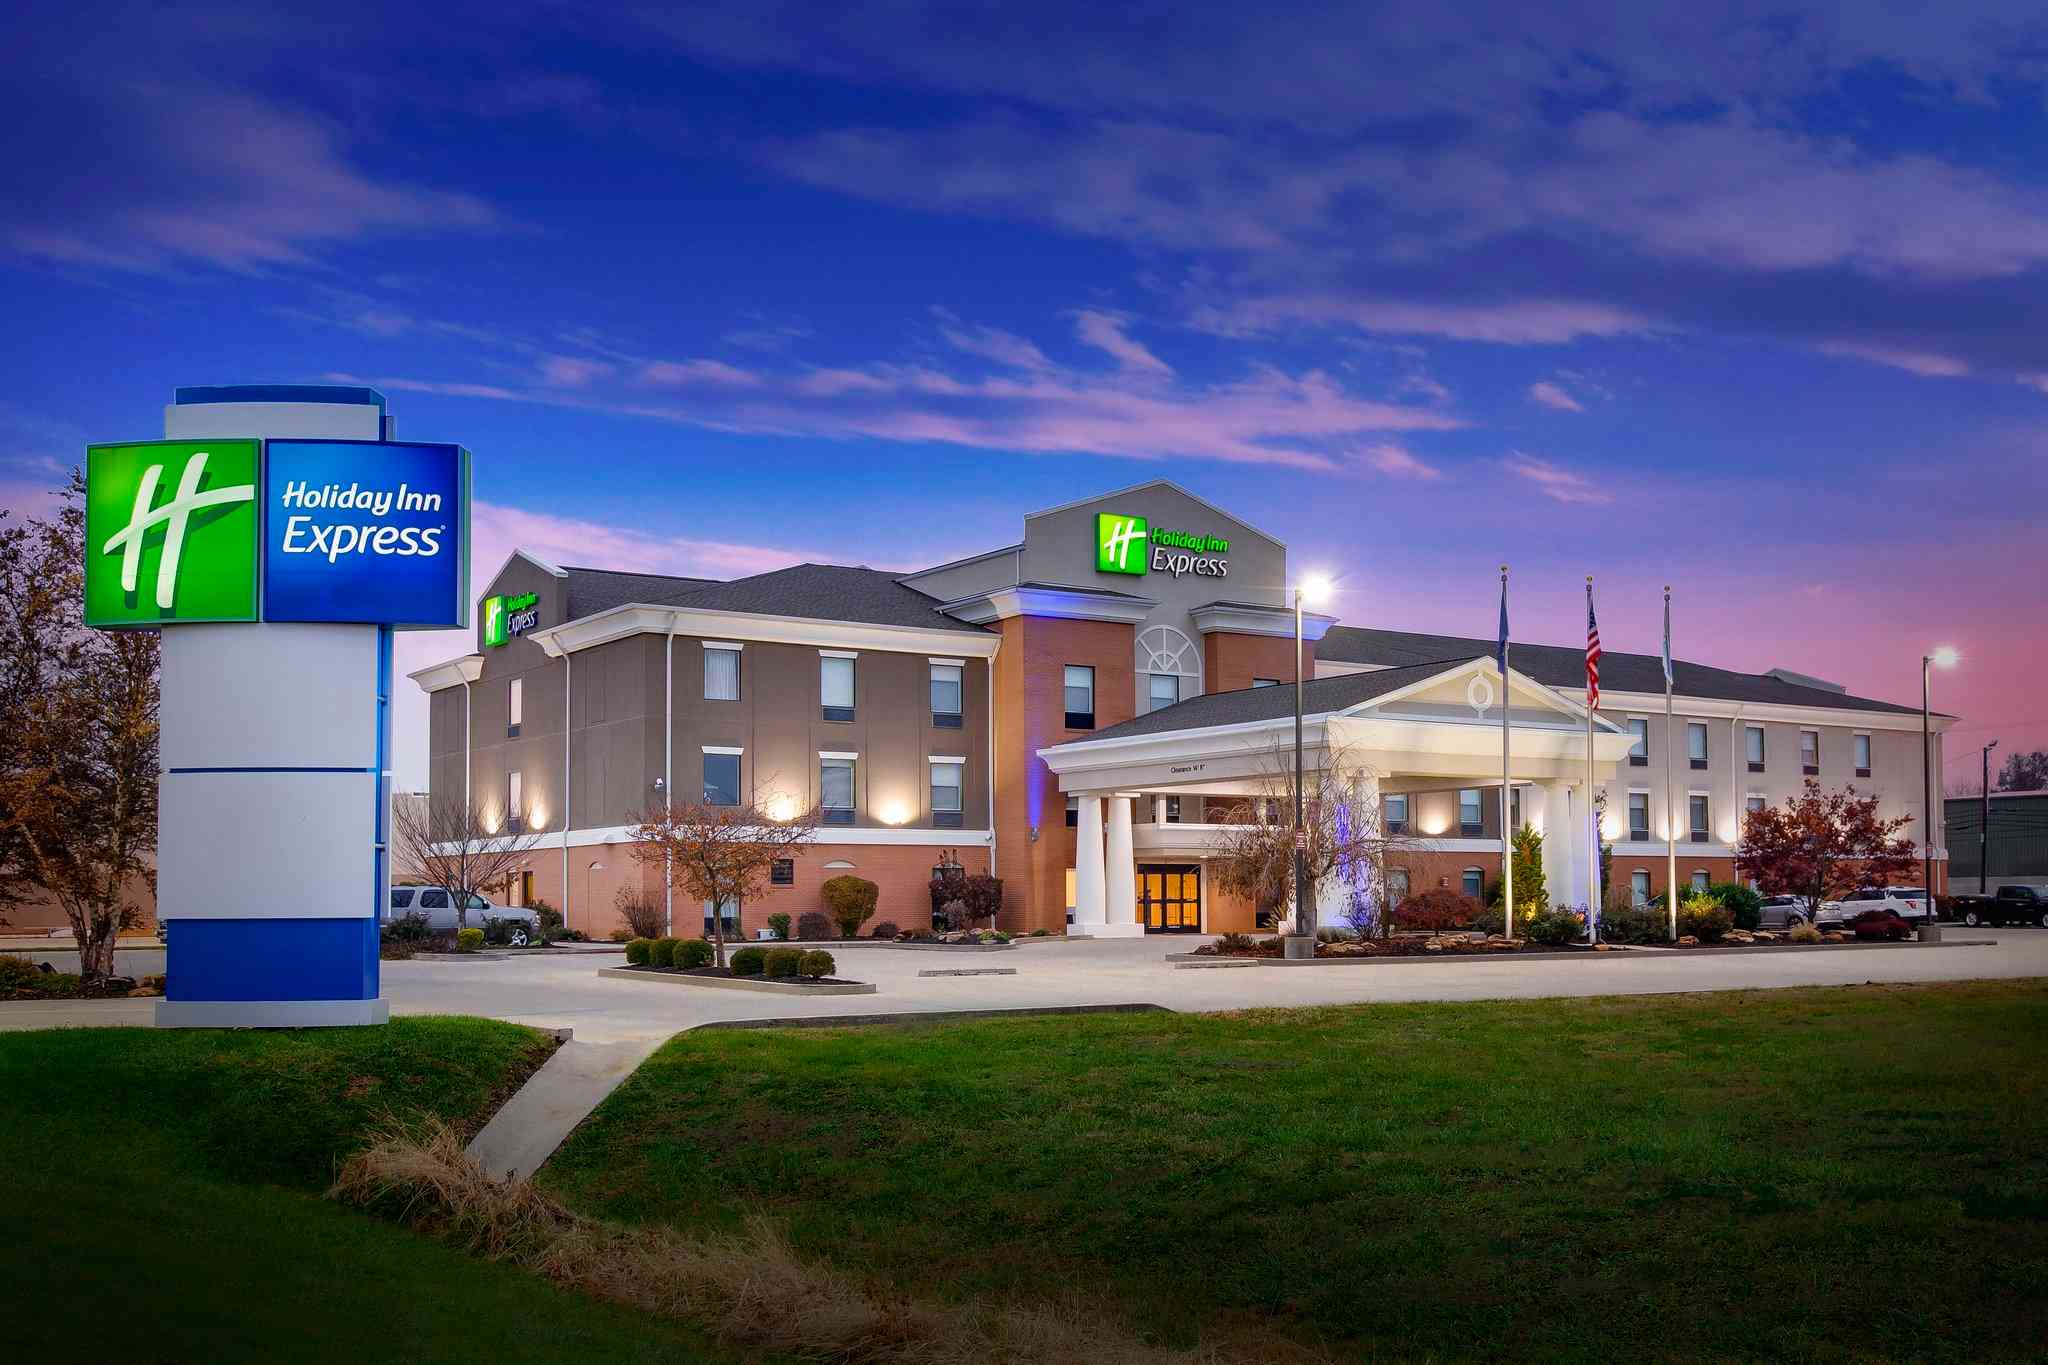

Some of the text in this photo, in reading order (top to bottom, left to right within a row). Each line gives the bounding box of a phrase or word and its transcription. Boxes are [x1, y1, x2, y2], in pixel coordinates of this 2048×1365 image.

[281, 480, 442, 517] Holiday Inn
[282, 515, 442, 564] Express
[1151, 527, 1228, 552] Holiday Inn
[1152, 546, 1228, 578] Express
